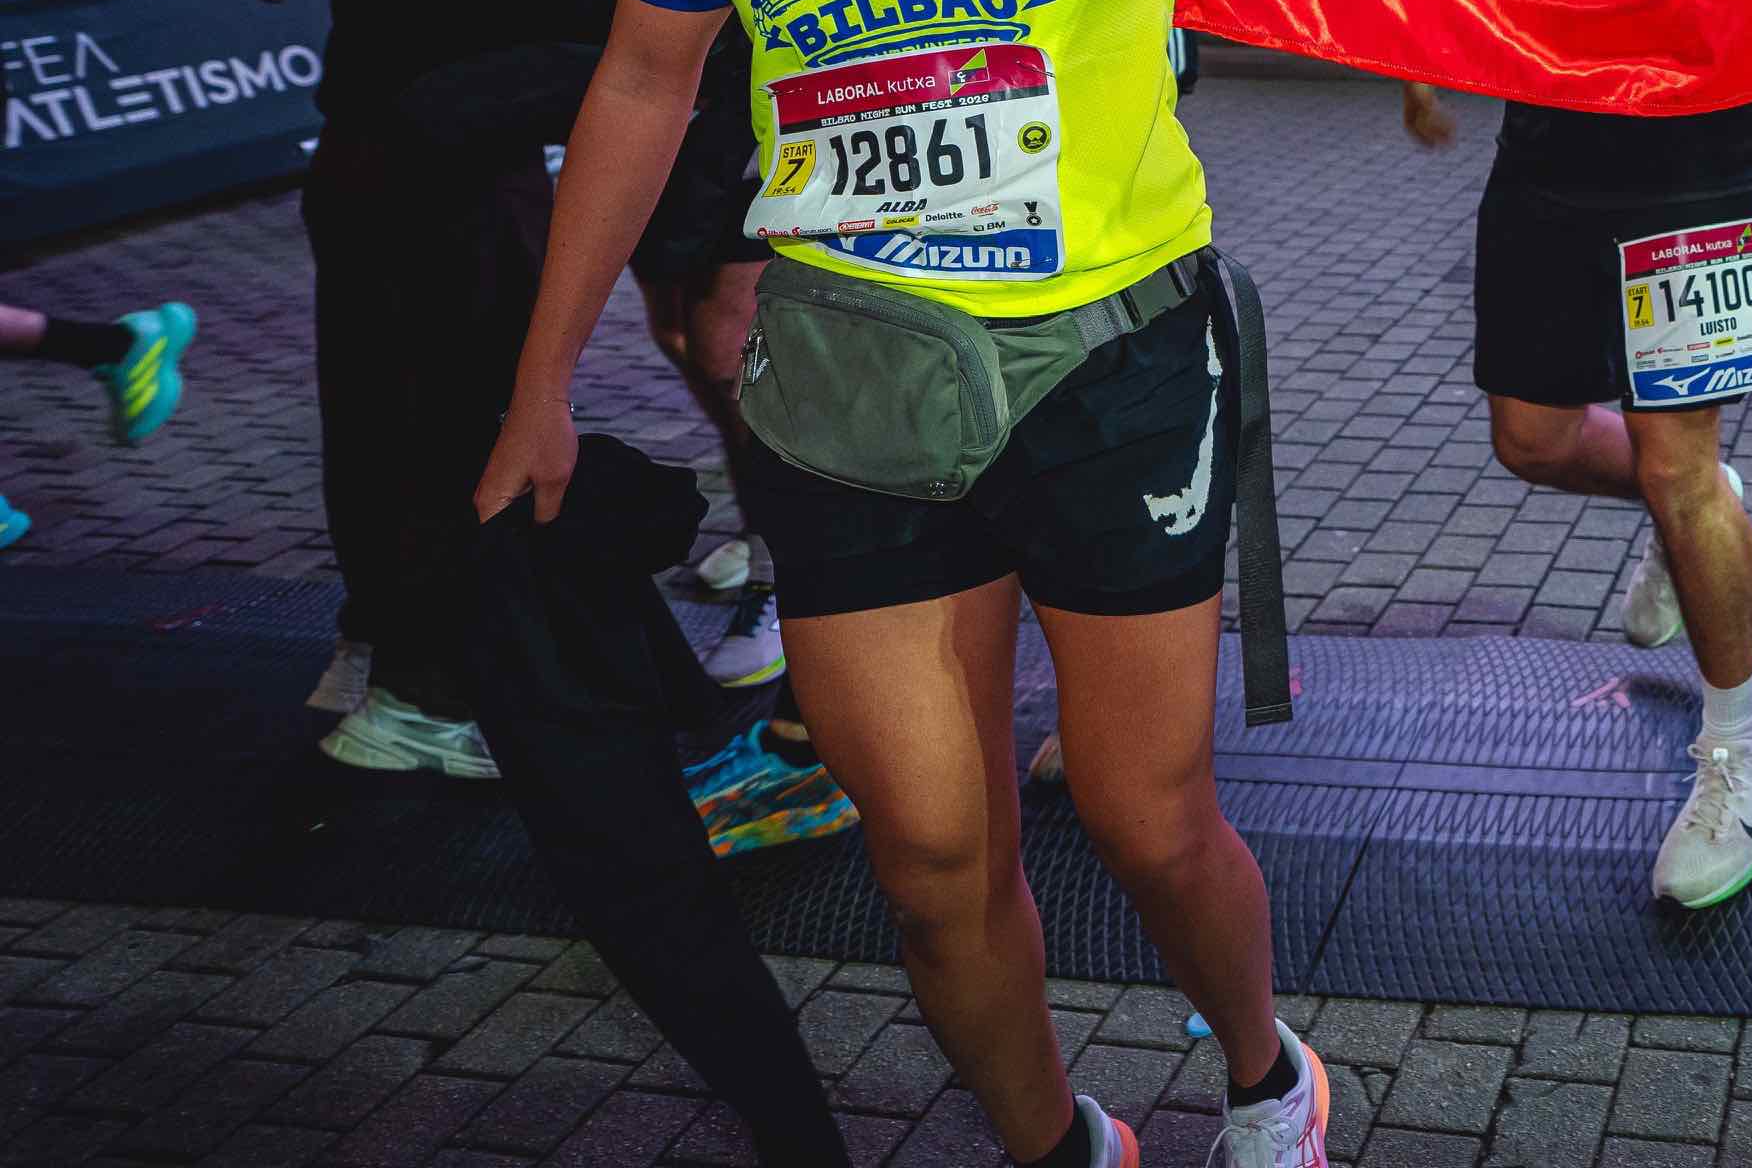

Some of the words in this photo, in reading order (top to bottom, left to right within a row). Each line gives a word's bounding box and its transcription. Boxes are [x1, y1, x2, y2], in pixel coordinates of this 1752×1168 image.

[4, 45, 323, 149] ATLETISMO
[817, 82, 884, 105] LABORAL
[887, 75, 936, 93] kutxa
[895, 104, 916, 115] RUN
[922, 99, 953, 111] FEST
[958, 94, 989, 106] 2026
[783, 144, 813, 159] START
[828, 113, 992, 195] 12861
[779, 158, 806, 186] 7
[876, 198, 928, 213] ALBA
[1651, 243, 1704, 261] LABORAL
[1705, 239, 1732, 251] kutxa
[1633, 295, 1644, 319] 7
[1700, 317, 1738, 336] LUISTO
